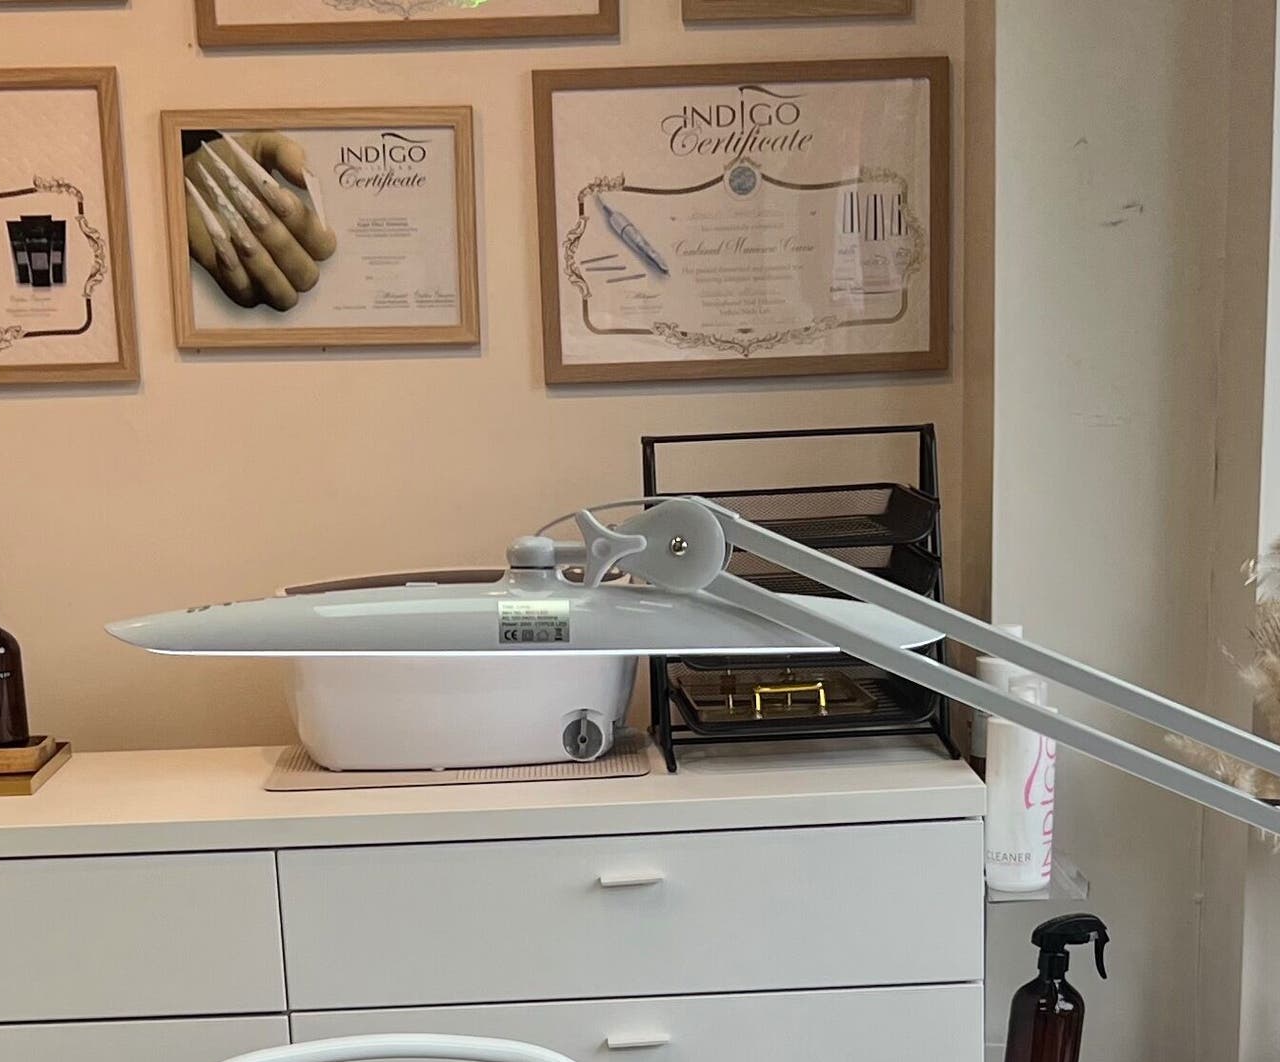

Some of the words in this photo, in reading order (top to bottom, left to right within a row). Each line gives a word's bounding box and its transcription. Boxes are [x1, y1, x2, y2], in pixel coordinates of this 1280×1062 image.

[683, 101, 800, 130] INDIGO
[661, 115, 813, 159] Certificate
[341, 144, 426, 166] INDIGO
[334, 163, 426, 195] Certificate
[986, 851, 1032, 863] CLEANER
